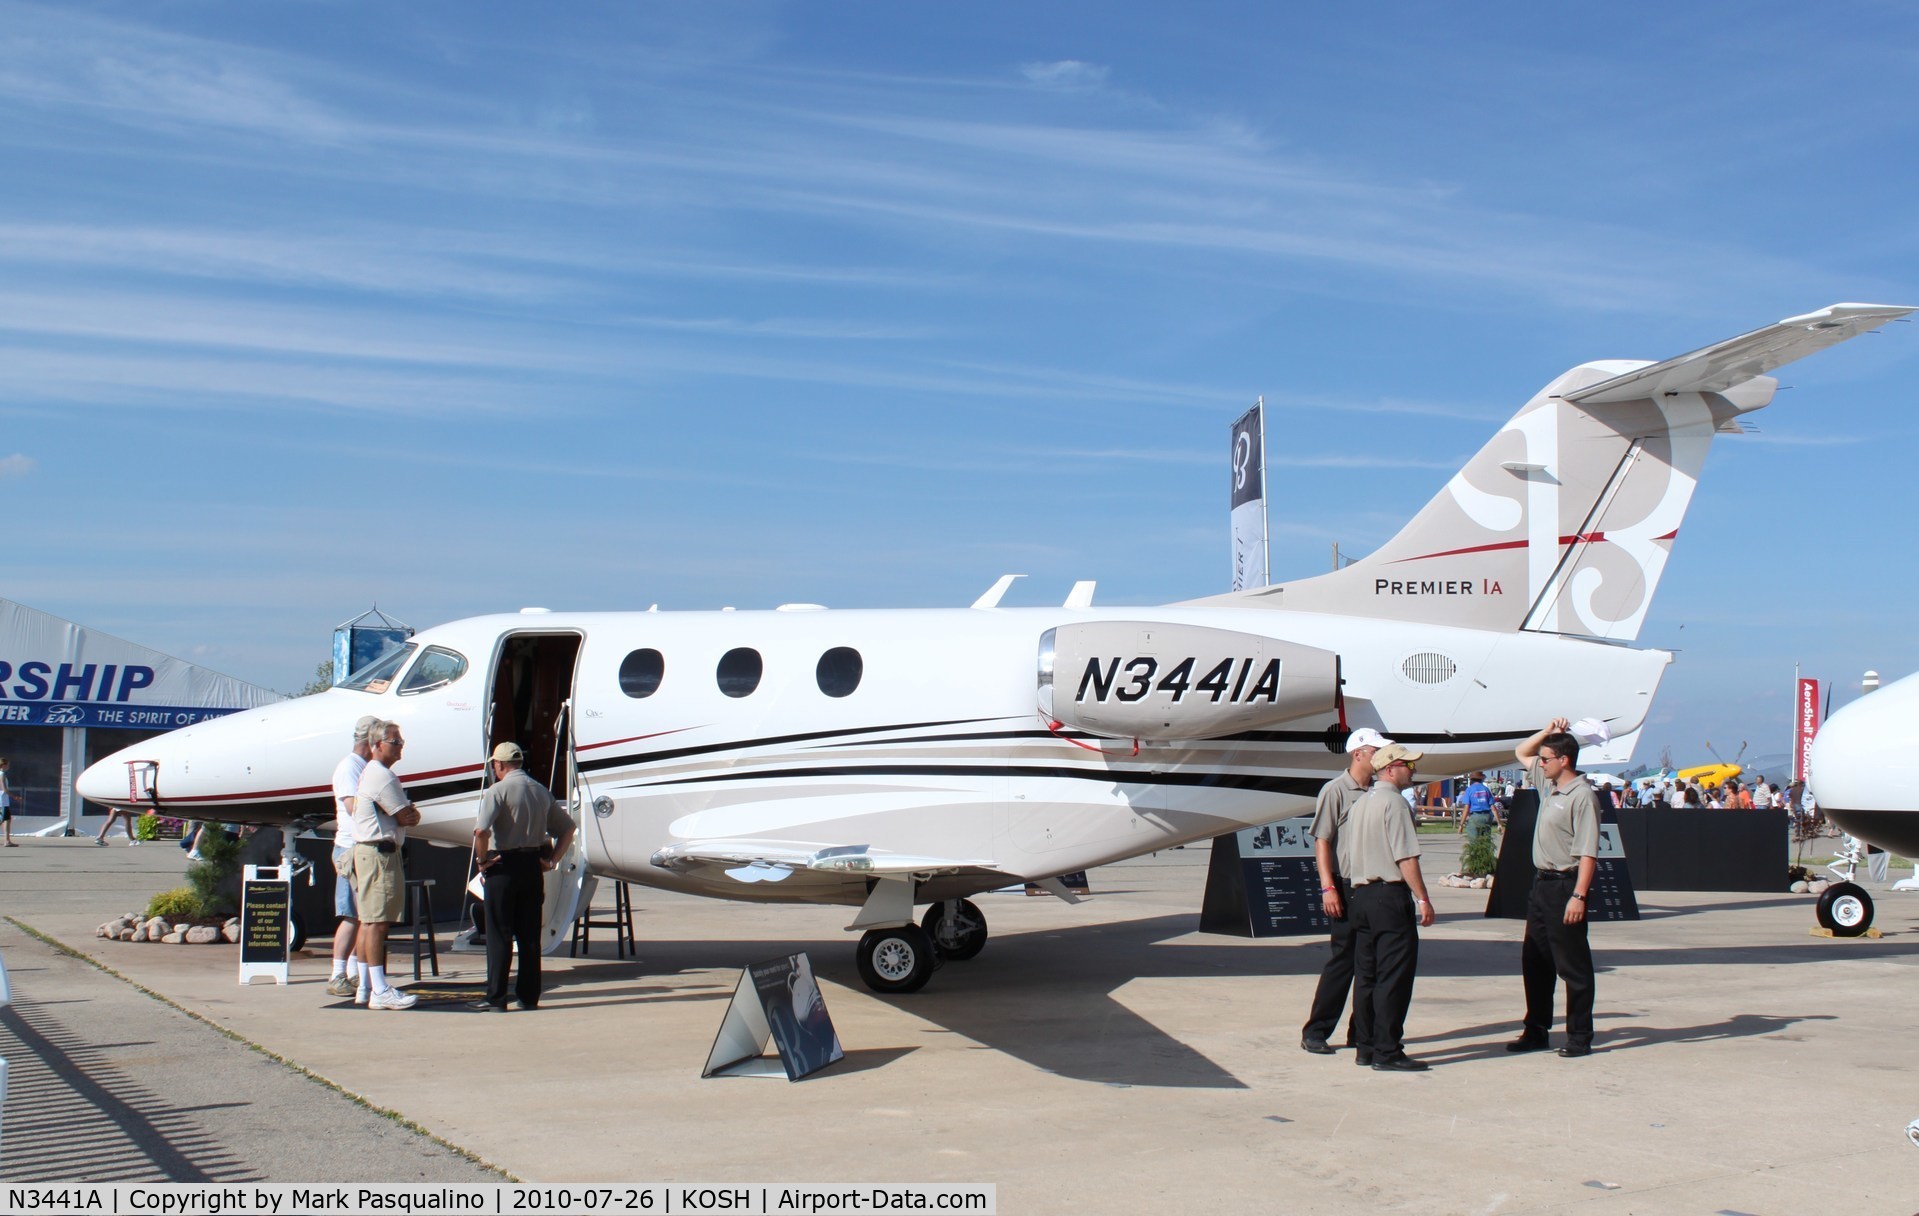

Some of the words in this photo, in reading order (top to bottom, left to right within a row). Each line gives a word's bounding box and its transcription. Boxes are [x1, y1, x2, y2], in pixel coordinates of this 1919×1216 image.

[1075, 657, 1283, 705] N3441A
[44, 713, 79, 724] EAA
[97, 710, 124, 723] THE
[128, 711, 172, 725] SPIRIT
[176, 713, 196, 725] OF
